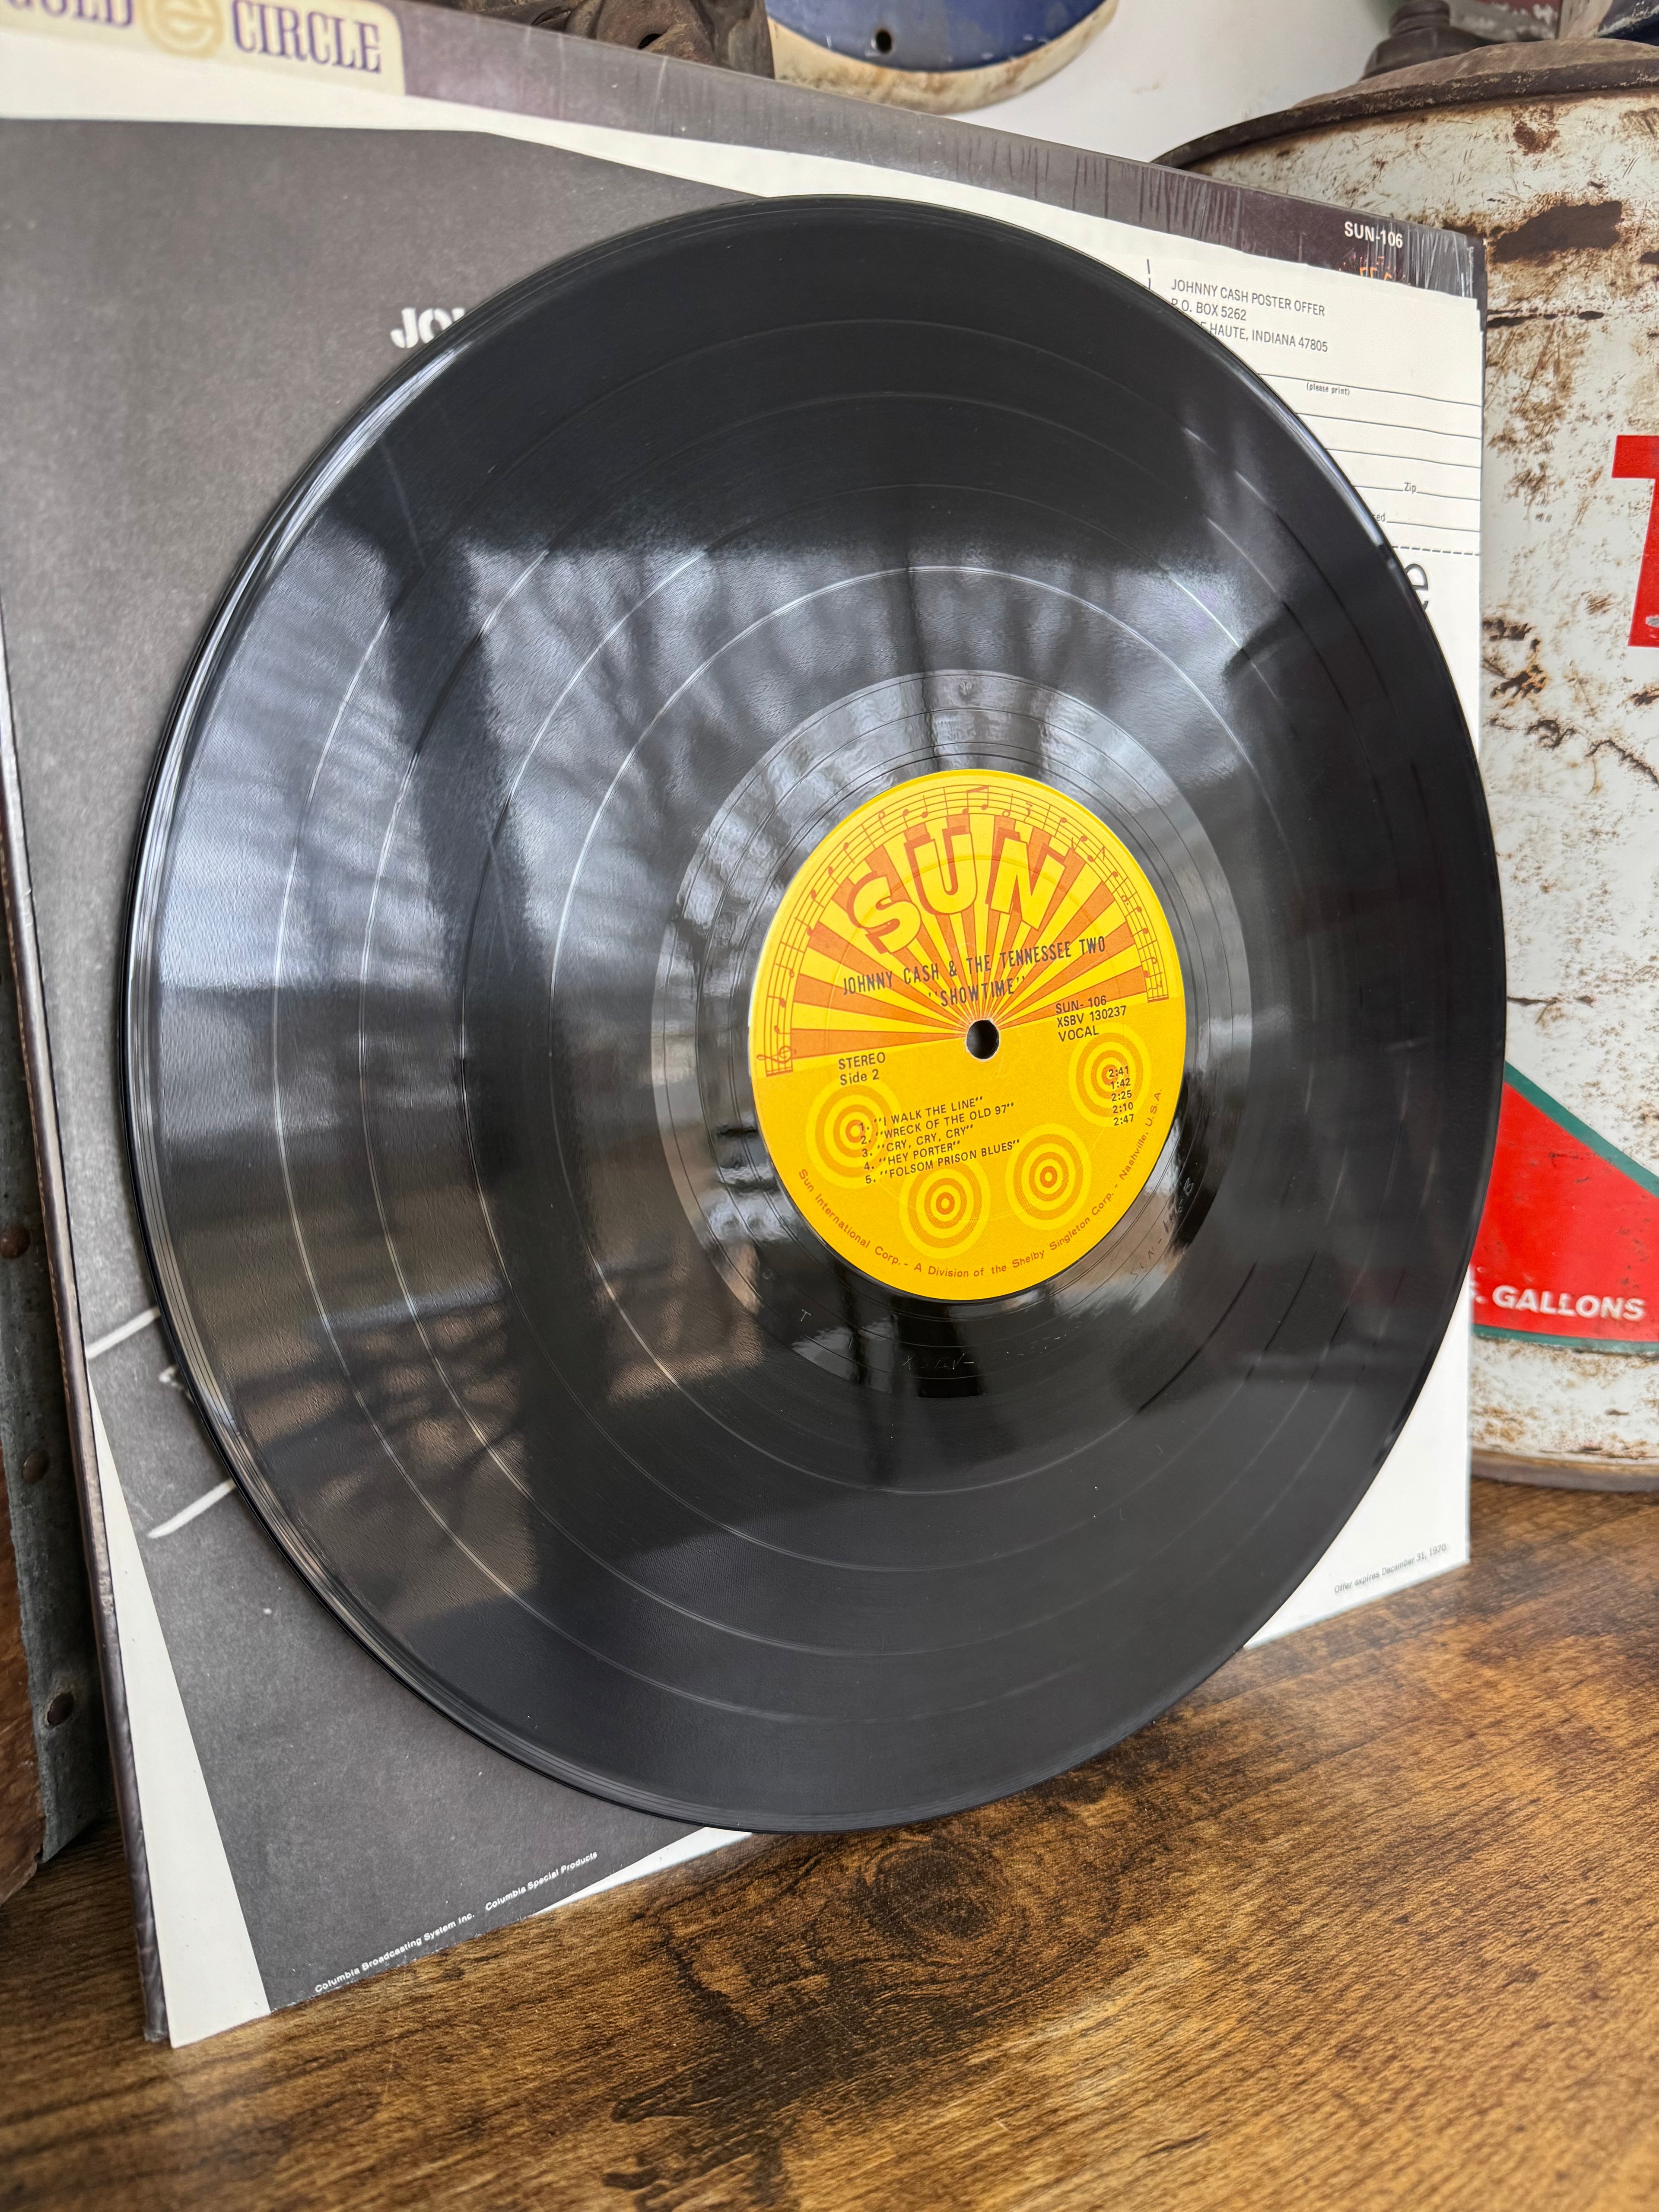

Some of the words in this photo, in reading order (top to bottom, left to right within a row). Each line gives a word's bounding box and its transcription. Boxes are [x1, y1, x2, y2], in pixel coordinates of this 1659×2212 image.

[232, 0, 381, 74] CIRCLE
[1344, 221, 1403, 248] SUN-106
[1171, 279, 1218, 297] JOHNNY
[1220, 286, 1249, 303] CASH
[1252, 292, 1292, 310] POSTER
[1294, 300, 1325, 317] OFFER
[1196, 301, 1218, 317] BOX
[1220, 306, 1247, 321] 5262
[390, 307, 465, 349] JO
[1210, 322, 1249, 341] HAUTE,
[1252, 329, 1296, 347] INDIANA
[1298, 337, 1328, 353] 47805
[1306, 382, 1328, 393] (please
[1331, 387, 1350, 396] print)
[1404, 482, 1417, 494] Zip
[847, 826, 1068, 953] SUN
[843, 970, 893, 995] JOHNNY
[903, 963, 939, 985] CASH
[949, 960, 957, 977] &
[966, 954, 991, 975] THE
[1000, 941, 1072, 968] TENNESSEE
[1079, 935, 1105, 954] TWO
[1057, 1012, 1085, 1028] XSBV
[1089, 1005, 1127, 1022] 130237
[1058, 1025, 1100, 1042] VOCAL
[838, 1051, 886, 1070] STEREO
[1108, 1065, 1129, 1078] 2:41
[840, 1071, 868, 1086] Side
[871, 1068, 880, 1081] 2
[1110, 1077, 1131, 1090] 1:42
[1111, 1090, 1132, 1102] 2:25
[1112, 1102, 1134, 1114] 2:10
[859, 1122, 870, 1131] 1.
[891, 1109, 922, 1124] WALK
[925, 1103, 947, 1117] THE
[950, 1096, 983, 1112] LINE"
[861, 1135, 871, 1145] 2.
[925, 1118, 940, 1130] OF
[944, 1113, 965, 1126] THE
[969, 1107, 991, 1121] OLD
[1113, 1113, 1134, 1126] 2:47
[861, 1148, 873, 1158] 3.
[916, 1132, 941, 1146] CRY,
[945, 1124, 974, 1139] CRY"
[863, 1161, 875, 1171] 4.
[913, 1140, 961, 1160] PORTER"
[865, 1174, 876, 1185] 5.
[938, 1149, 977, 1167] PRISON
[981, 1139, 1020, 1157] BLUES"
[799, 1168, 814, 1192] Sun
[815, 1193, 871, 1249] International
[874, 1246, 901, 1265] Corp.
[914, 1262, 922, 1272] A
[928, 1265, 969, 1278] Division
[973, 1268, 985, 1277] of
[991, 1264, 1007, 1274] the
[1012, 1249, 1045, 1268] Shelby
[1049, 1217, 1091, 1250] Singleton
[1091, 1192, 1114, 1216] Corp.
[1119, 1132, 1149, 1180] Nashville,
[1492, 1284, 1646, 1321] GALLONS
[1334, 1581, 1354, 1593] Offer
[1354, 1570, 1380, 1586] expires
[1382, 1557, 1415, 1576] December
[1416, 1551, 1427, 1562] 31,
[1429, 1543, 1447, 1556] 1970
[315, 1967, 360, 1993] Columbia
[361, 1937, 423, 1971] Broadcasting
[423, 1921, 457, 1942] System
[458, 1912, 475, 1924] Inc.
[485, 1886, 527, 1911] Columbia
[527, 1868, 559, 1890] Special
[560, 1851, 598, 1875] Products
